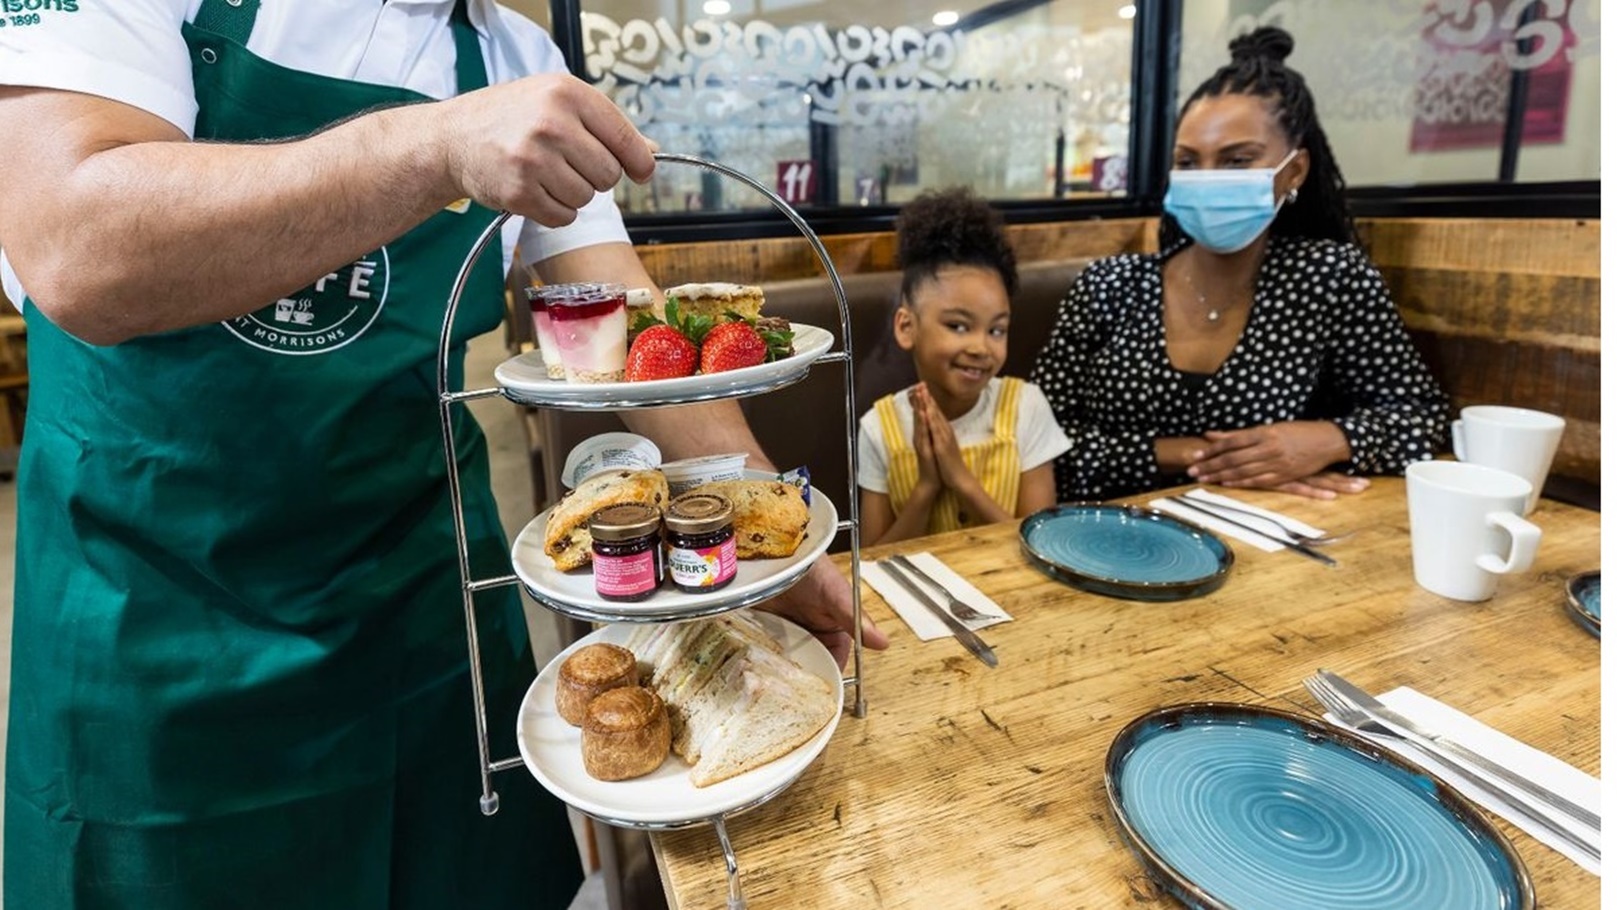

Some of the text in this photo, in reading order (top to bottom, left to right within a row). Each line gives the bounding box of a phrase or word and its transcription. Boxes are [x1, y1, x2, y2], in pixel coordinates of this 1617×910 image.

[9, 13, 41, 26] 1899
[782, 162, 812, 202] 11
[254, 328, 345, 346] MORRISONS
